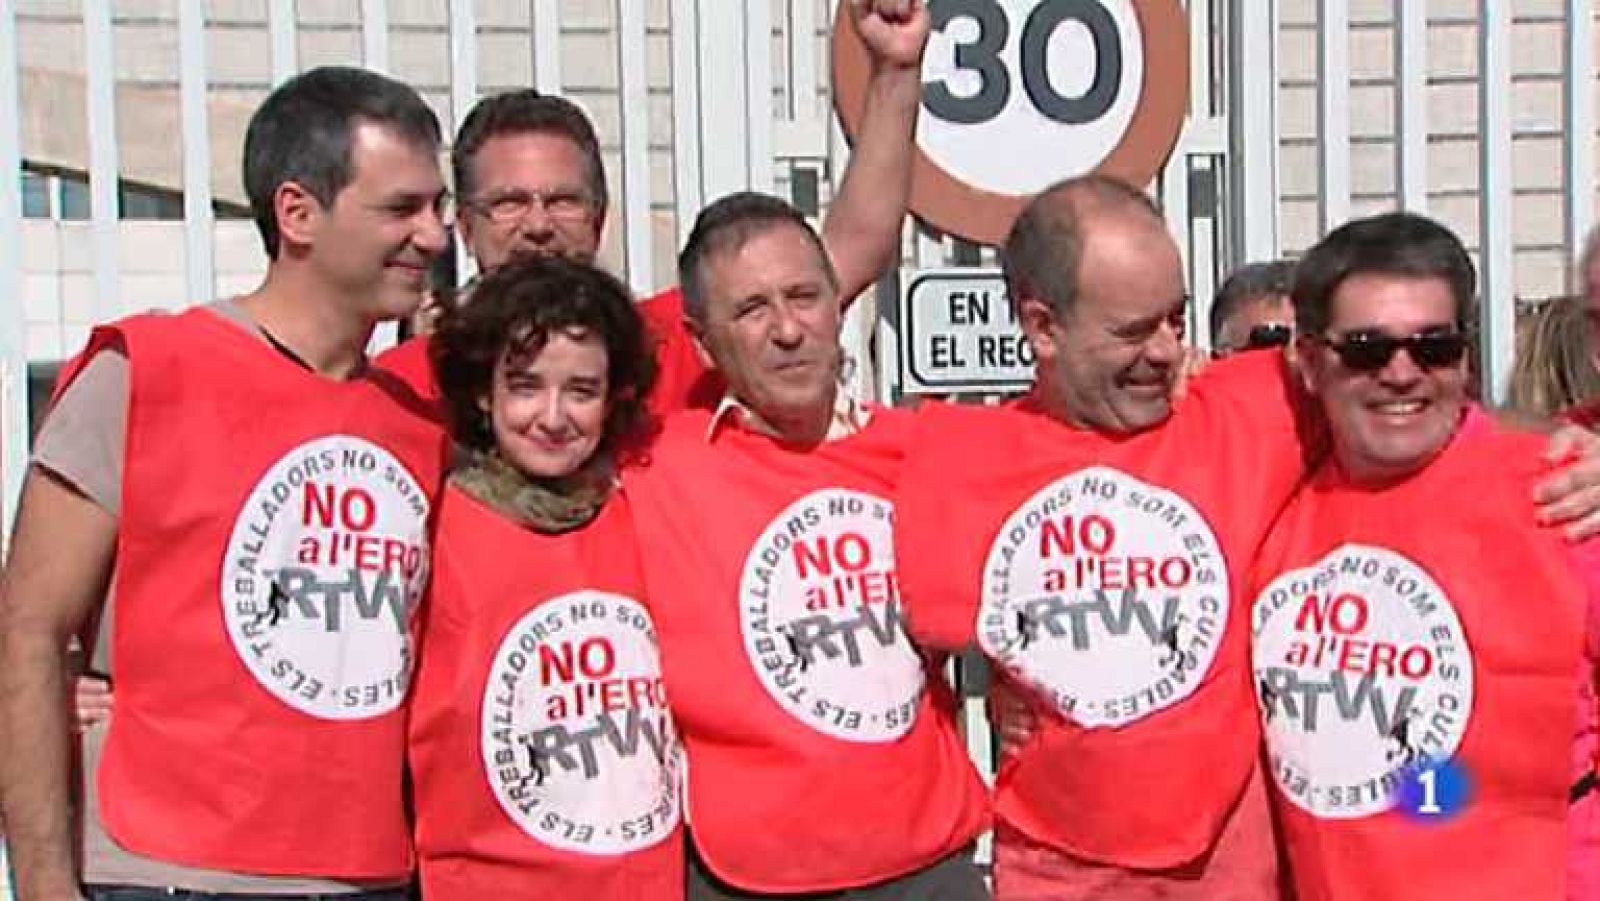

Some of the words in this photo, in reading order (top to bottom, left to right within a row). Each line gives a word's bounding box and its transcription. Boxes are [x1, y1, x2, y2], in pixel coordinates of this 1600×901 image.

[921, 0, 1123, 125] 30
[949, 292, 990, 325] EN
[931, 337, 966, 369] EL
[978, 336, 1037, 369] REC
[341, 450, 377, 470] NO
[302, 481, 377, 532] NO
[386, 466, 426, 517] SOM
[828, 497, 864, 517] NO
[1082, 477, 1118, 500] NO
[1129, 491, 1189, 529] SOM
[234, 451, 336, 658] TREBALLADORS
[792, 532, 871, 580] NO
[1039, 514, 1116, 559] NO
[1182, 533, 1218, 584] ELS
[569, 600, 607, 622] NO
[749, 507, 821, 704] TREBALLADORS
[1294, 592, 1369, 635] NO
[1341, 556, 1379, 578] NO
[1383, 566, 1438, 618] SOM
[1431, 624, 1460, 683] ELS
[270, 659, 324, 701] ELS
[537, 636, 616, 687] NO
[1102, 596, 1219, 719] CULPABLES
[492, 612, 564, 814] TREBALLADORS
[813, 699, 862, 729] ELS
[539, 812, 595, 843] ELS
